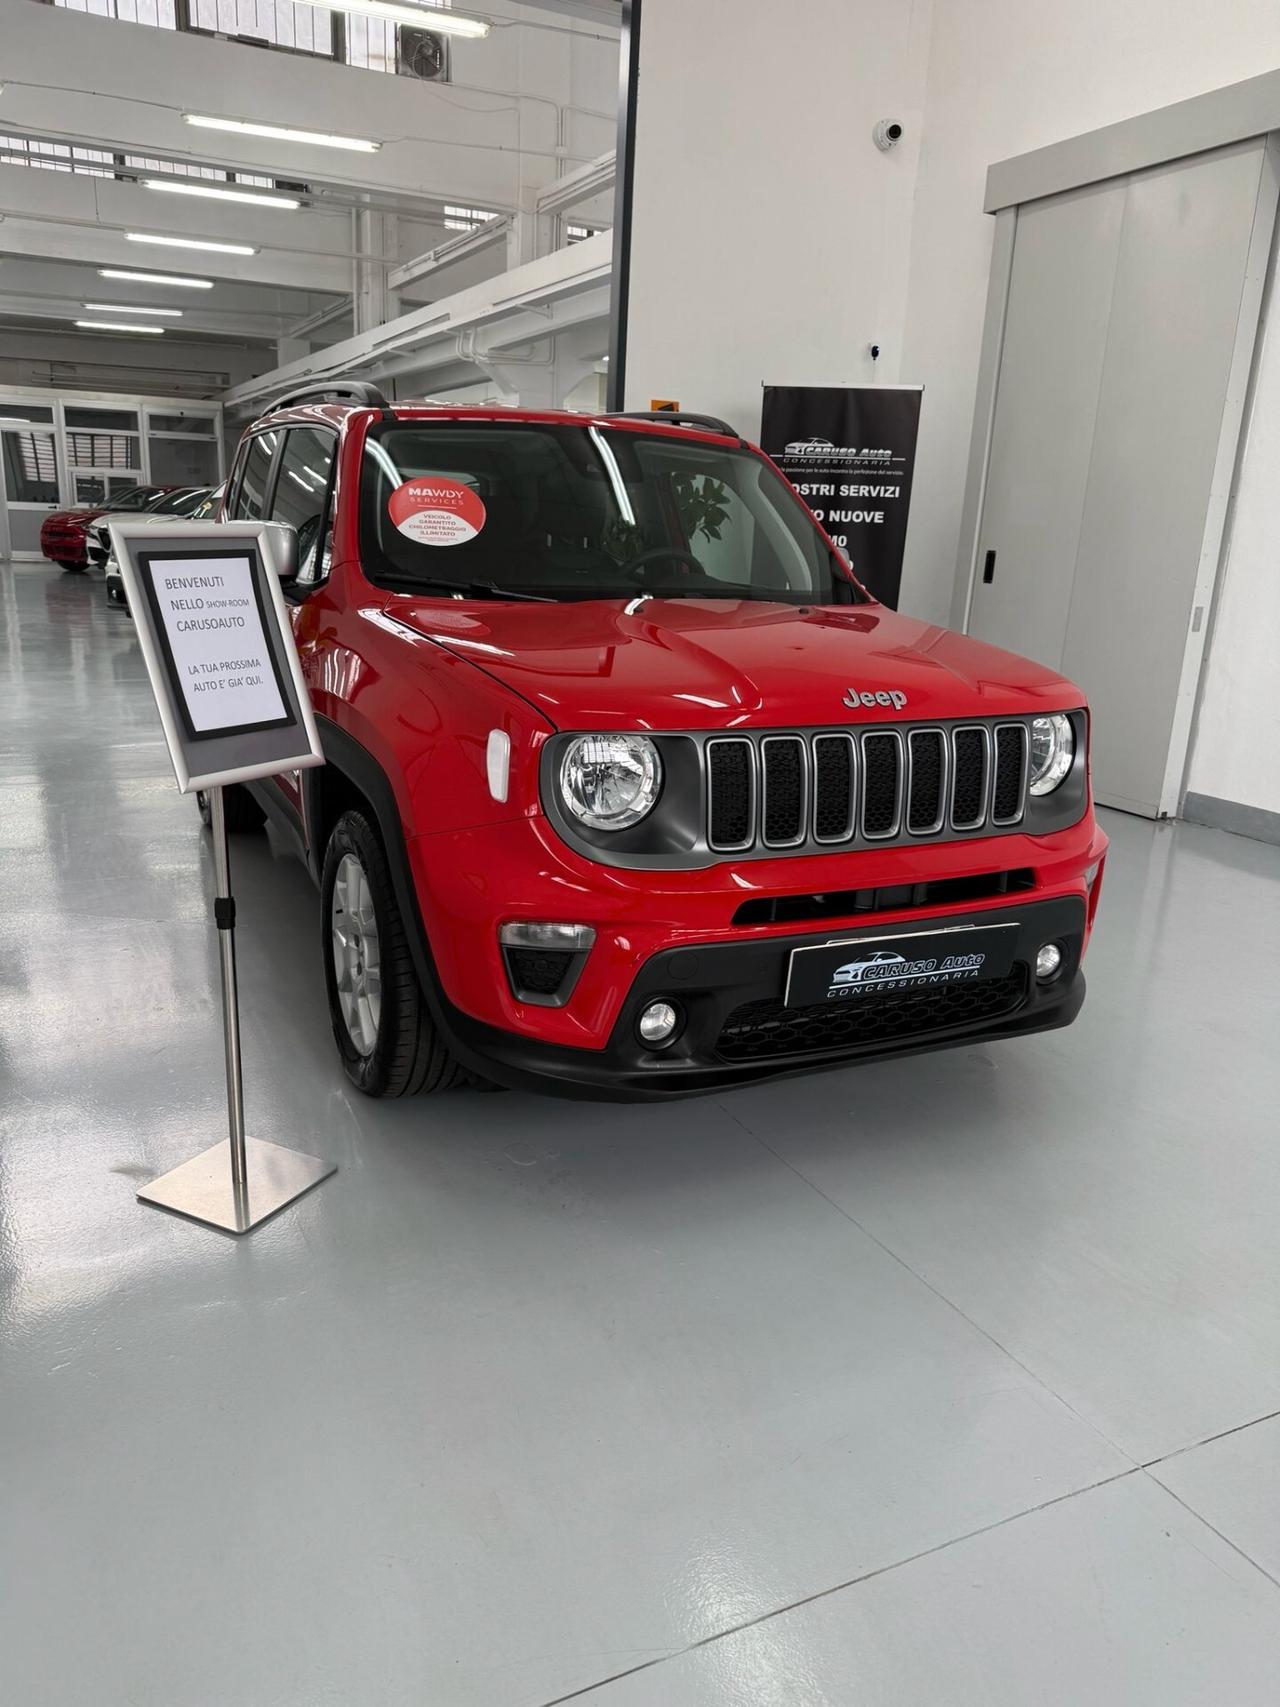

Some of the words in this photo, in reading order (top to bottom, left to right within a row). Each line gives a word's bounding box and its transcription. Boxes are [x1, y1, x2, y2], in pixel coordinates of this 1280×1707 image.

[804, 447, 856, 457] CARUSO
[859, 448, 892, 457] Auto
[408, 487, 464, 498] MAWDY
[791, 483, 835, 496] OSTRI
[839, 485, 900, 498] SERVIZI
[409, 497, 464, 505] SERVICES
[829, 510, 884, 523] NUOVE
[165, 576, 225, 590] BENVENUTI
[170, 598, 204, 611] NELLO
[205, 598, 250, 609] SHOW-ROOM
[176, 616, 246, 632] CARUSOAUTO
[187, 665, 200, 676] LA
[200, 663, 219, 674] TUA
[219, 658, 262, 672] PROSSIMA
[193, 680, 218, 692] AUTO
[245, 675, 264, 687] QUI.
[842, 687, 908, 711] Jeep
[862, 958, 937, 981] CARUSO
[939, 952, 986, 970] Auto
[826, 968, 980, 999] CONCESSIONARIA
